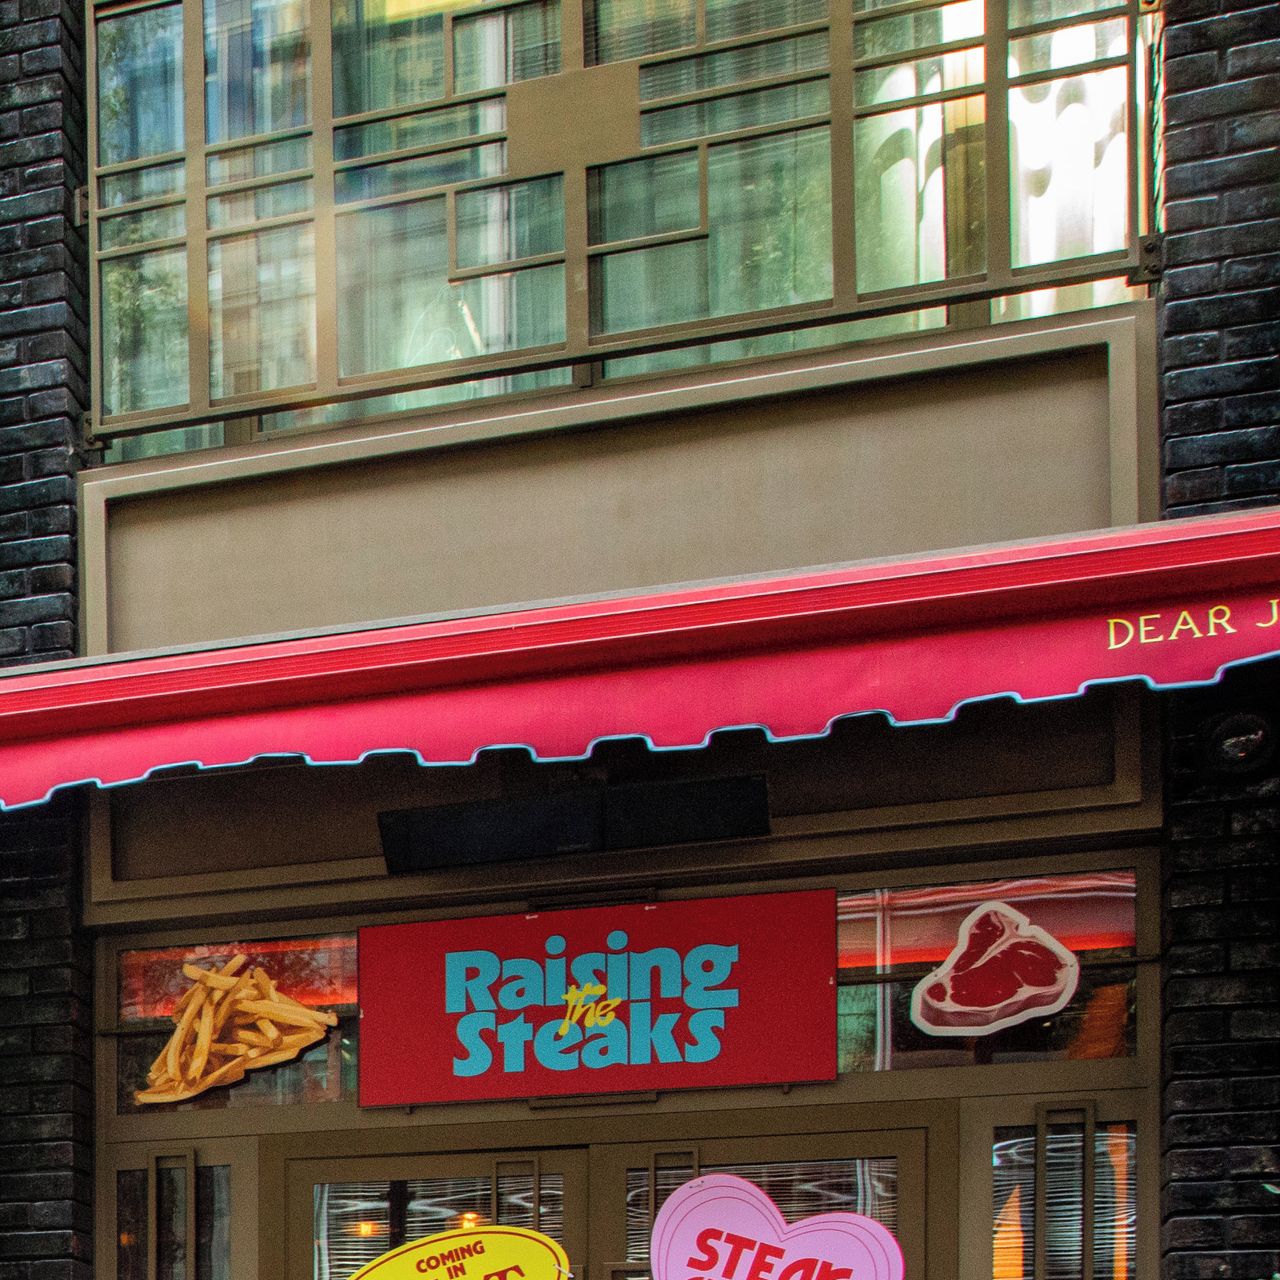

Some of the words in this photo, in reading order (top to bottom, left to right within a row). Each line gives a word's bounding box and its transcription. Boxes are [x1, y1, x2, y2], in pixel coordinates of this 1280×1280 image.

[1106, 604, 1238, 650] DEAR
[444, 930, 740, 1013] Raising
[558, 982, 622, 1036] the
[452, 1002, 725, 1078] Steaks
[416, 1240, 486, 1273] COMING
[446, 1262, 467, 1279] IN
